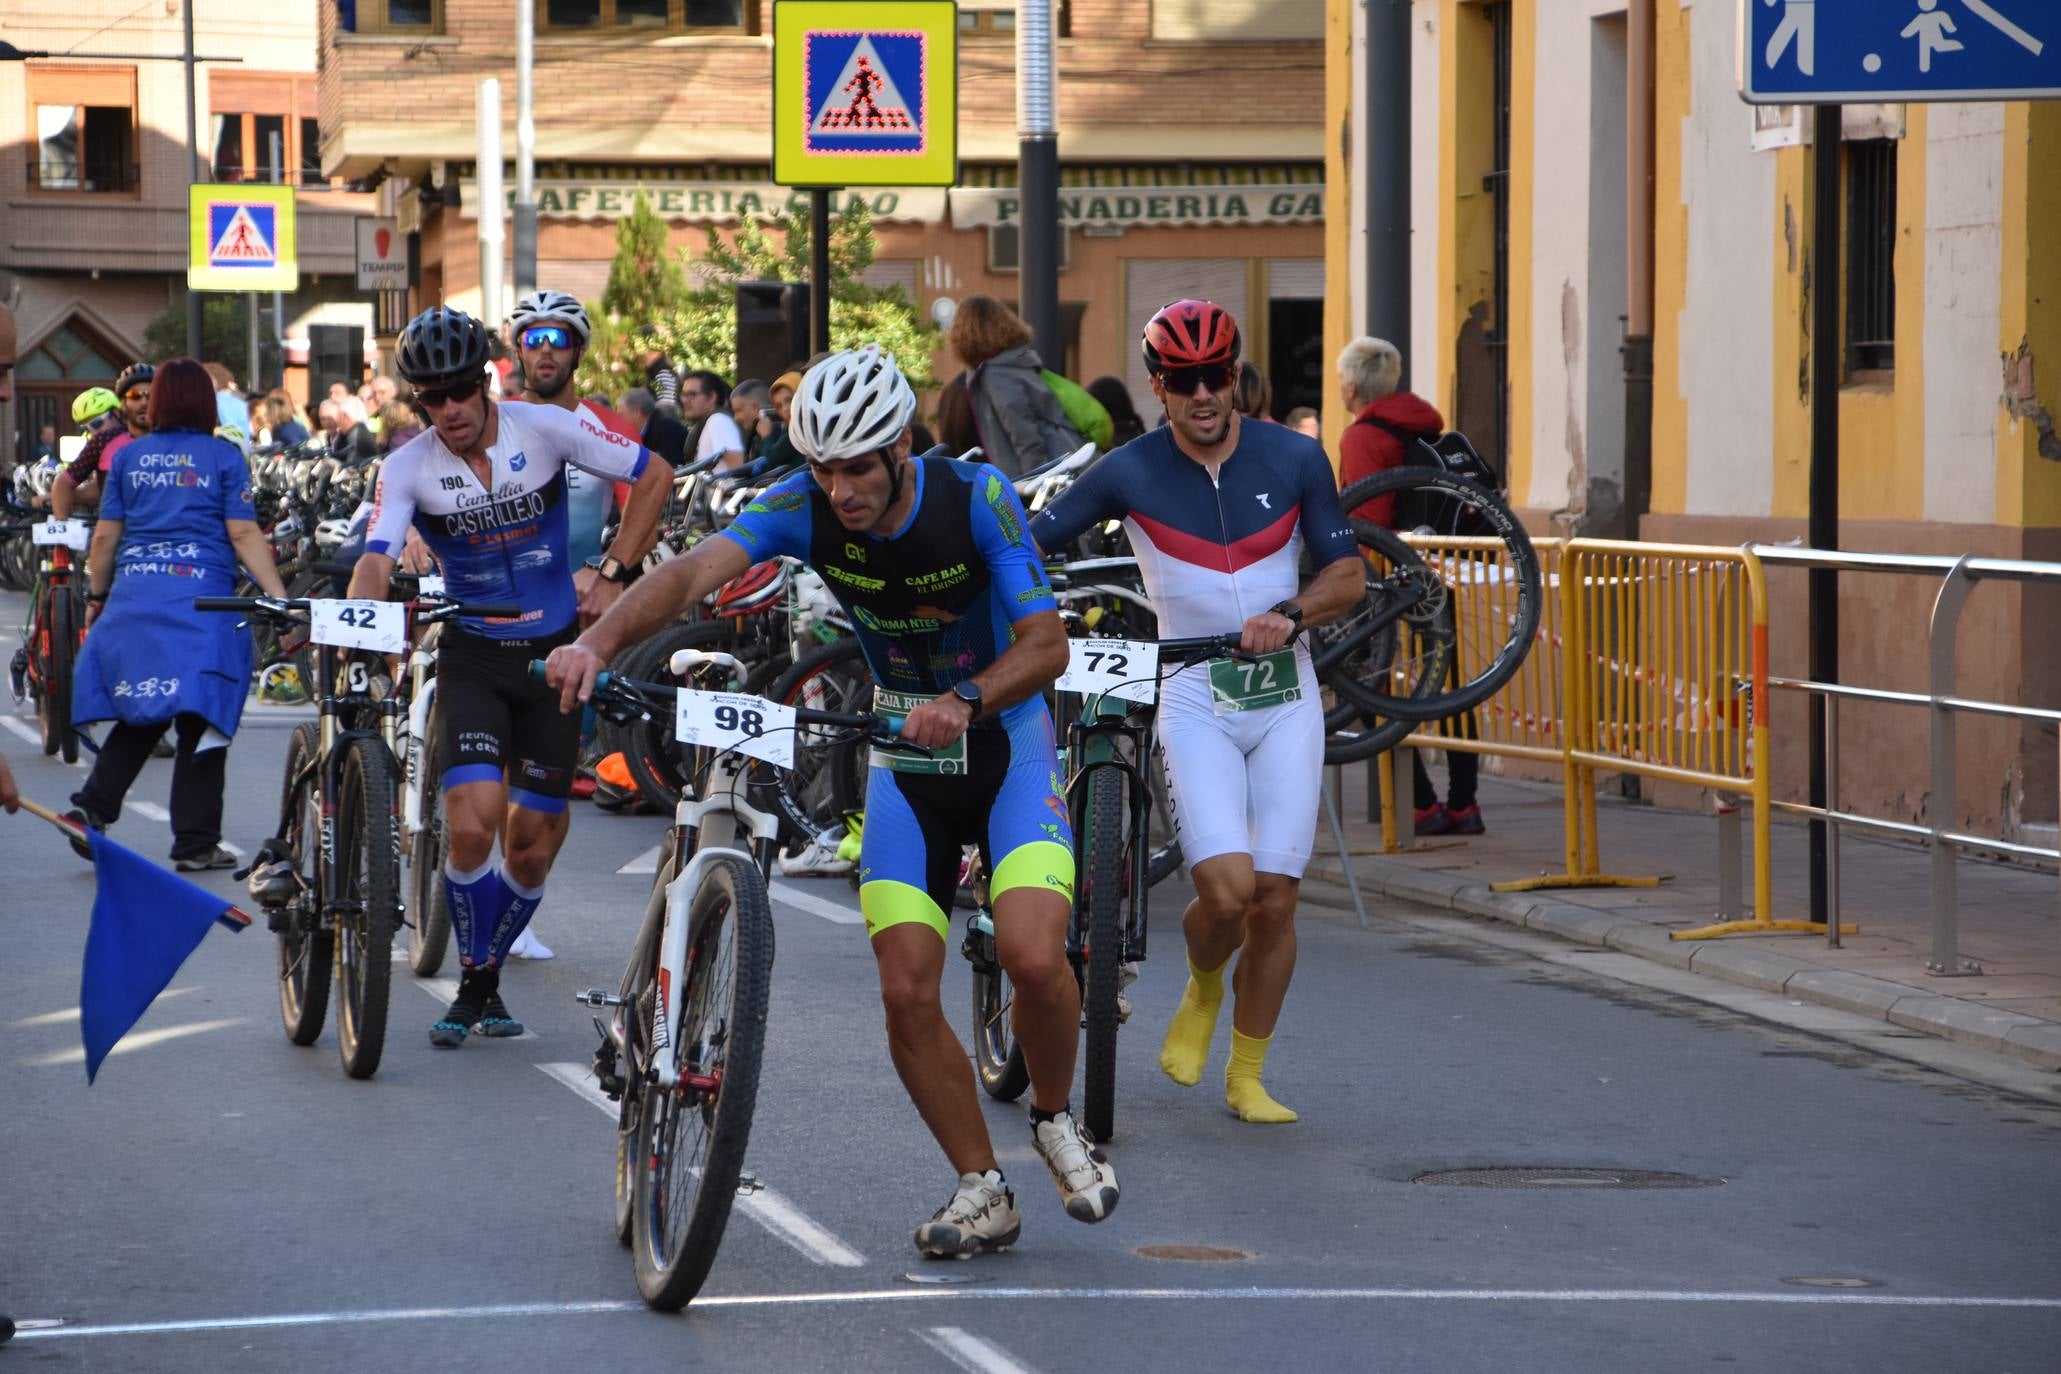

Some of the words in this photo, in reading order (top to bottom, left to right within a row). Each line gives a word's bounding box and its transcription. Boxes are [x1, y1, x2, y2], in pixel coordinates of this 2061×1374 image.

[997, 193, 1249, 220] PNADERIA
[580, 418, 631, 448] MUNDO
[139, 453, 197, 468] OFICIAL
[445, 490, 545, 537] CASTRILLEJO
[940, 563, 967, 580] BAR
[338, 607, 377, 629] 42
[1084, 651, 1128, 677] 72
[1237, 660, 1277, 692] 72
[714, 705, 764, 738] 98
